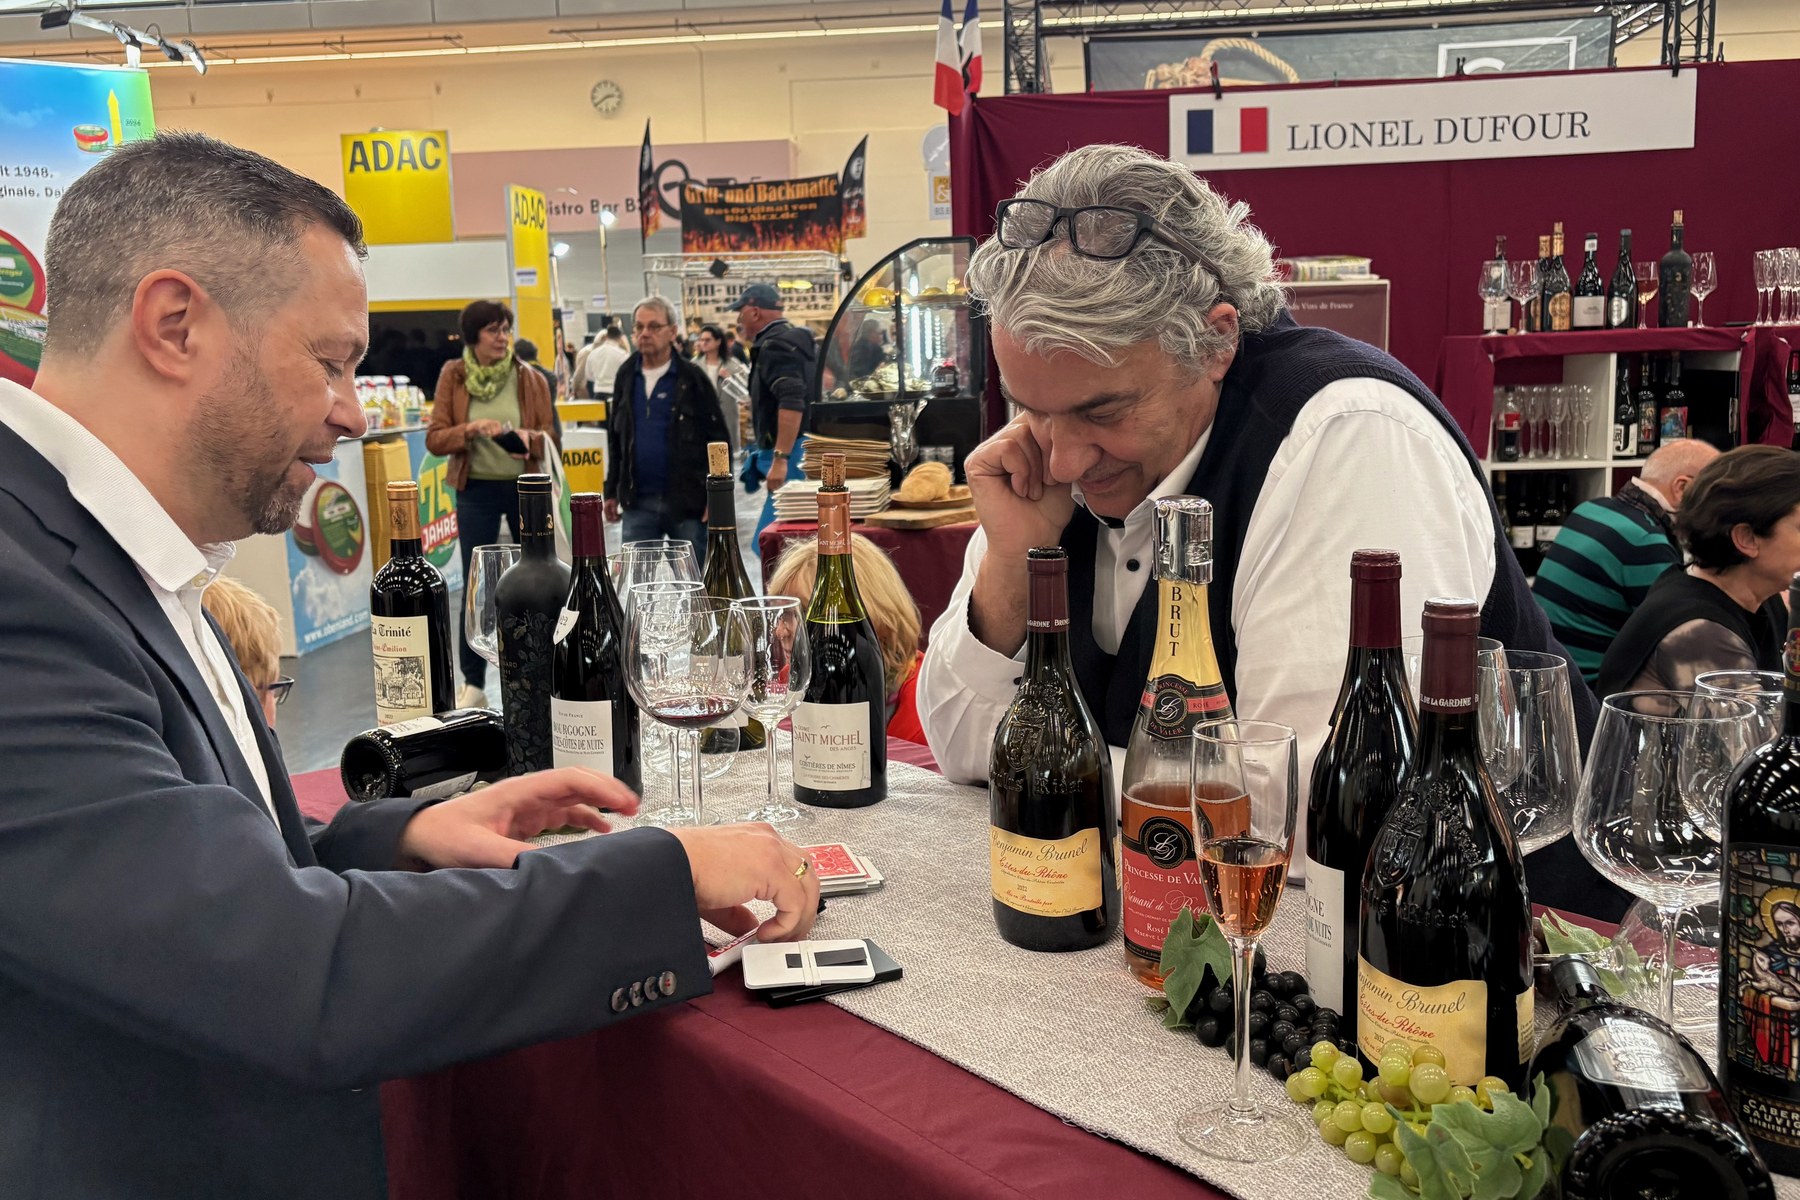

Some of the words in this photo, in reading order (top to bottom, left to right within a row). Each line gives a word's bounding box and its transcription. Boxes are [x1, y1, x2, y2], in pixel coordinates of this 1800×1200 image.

[1287, 119, 1424, 152] LIONEL
[1433, 111, 1591, 146] DUFOUR
[349, 137, 441, 173] ADAC
[724, 183, 755, 204] und
[514, 191, 547, 231] ADAC
[546, 203, 584, 216] istro
[591, 199, 619, 214] Bar
[562, 449, 602, 467] ADAC
[422, 512, 457, 552] JAHRE
[378, 622, 412, 638] Trinité
[1168, 586, 1182, 657] BRUT
[1439, 696, 1472, 708] GARDINE
[794, 730, 818, 746] SAINT
[820, 729, 865, 747] MICHEL
[1036, 838, 1089, 862] Brunel
[1125, 858, 1164, 883] PRINCESSE
[1167, 875, 1182, 885] DE
[1155, 901, 1168, 911] de
[1396, 988, 1467, 1016] Brunel
